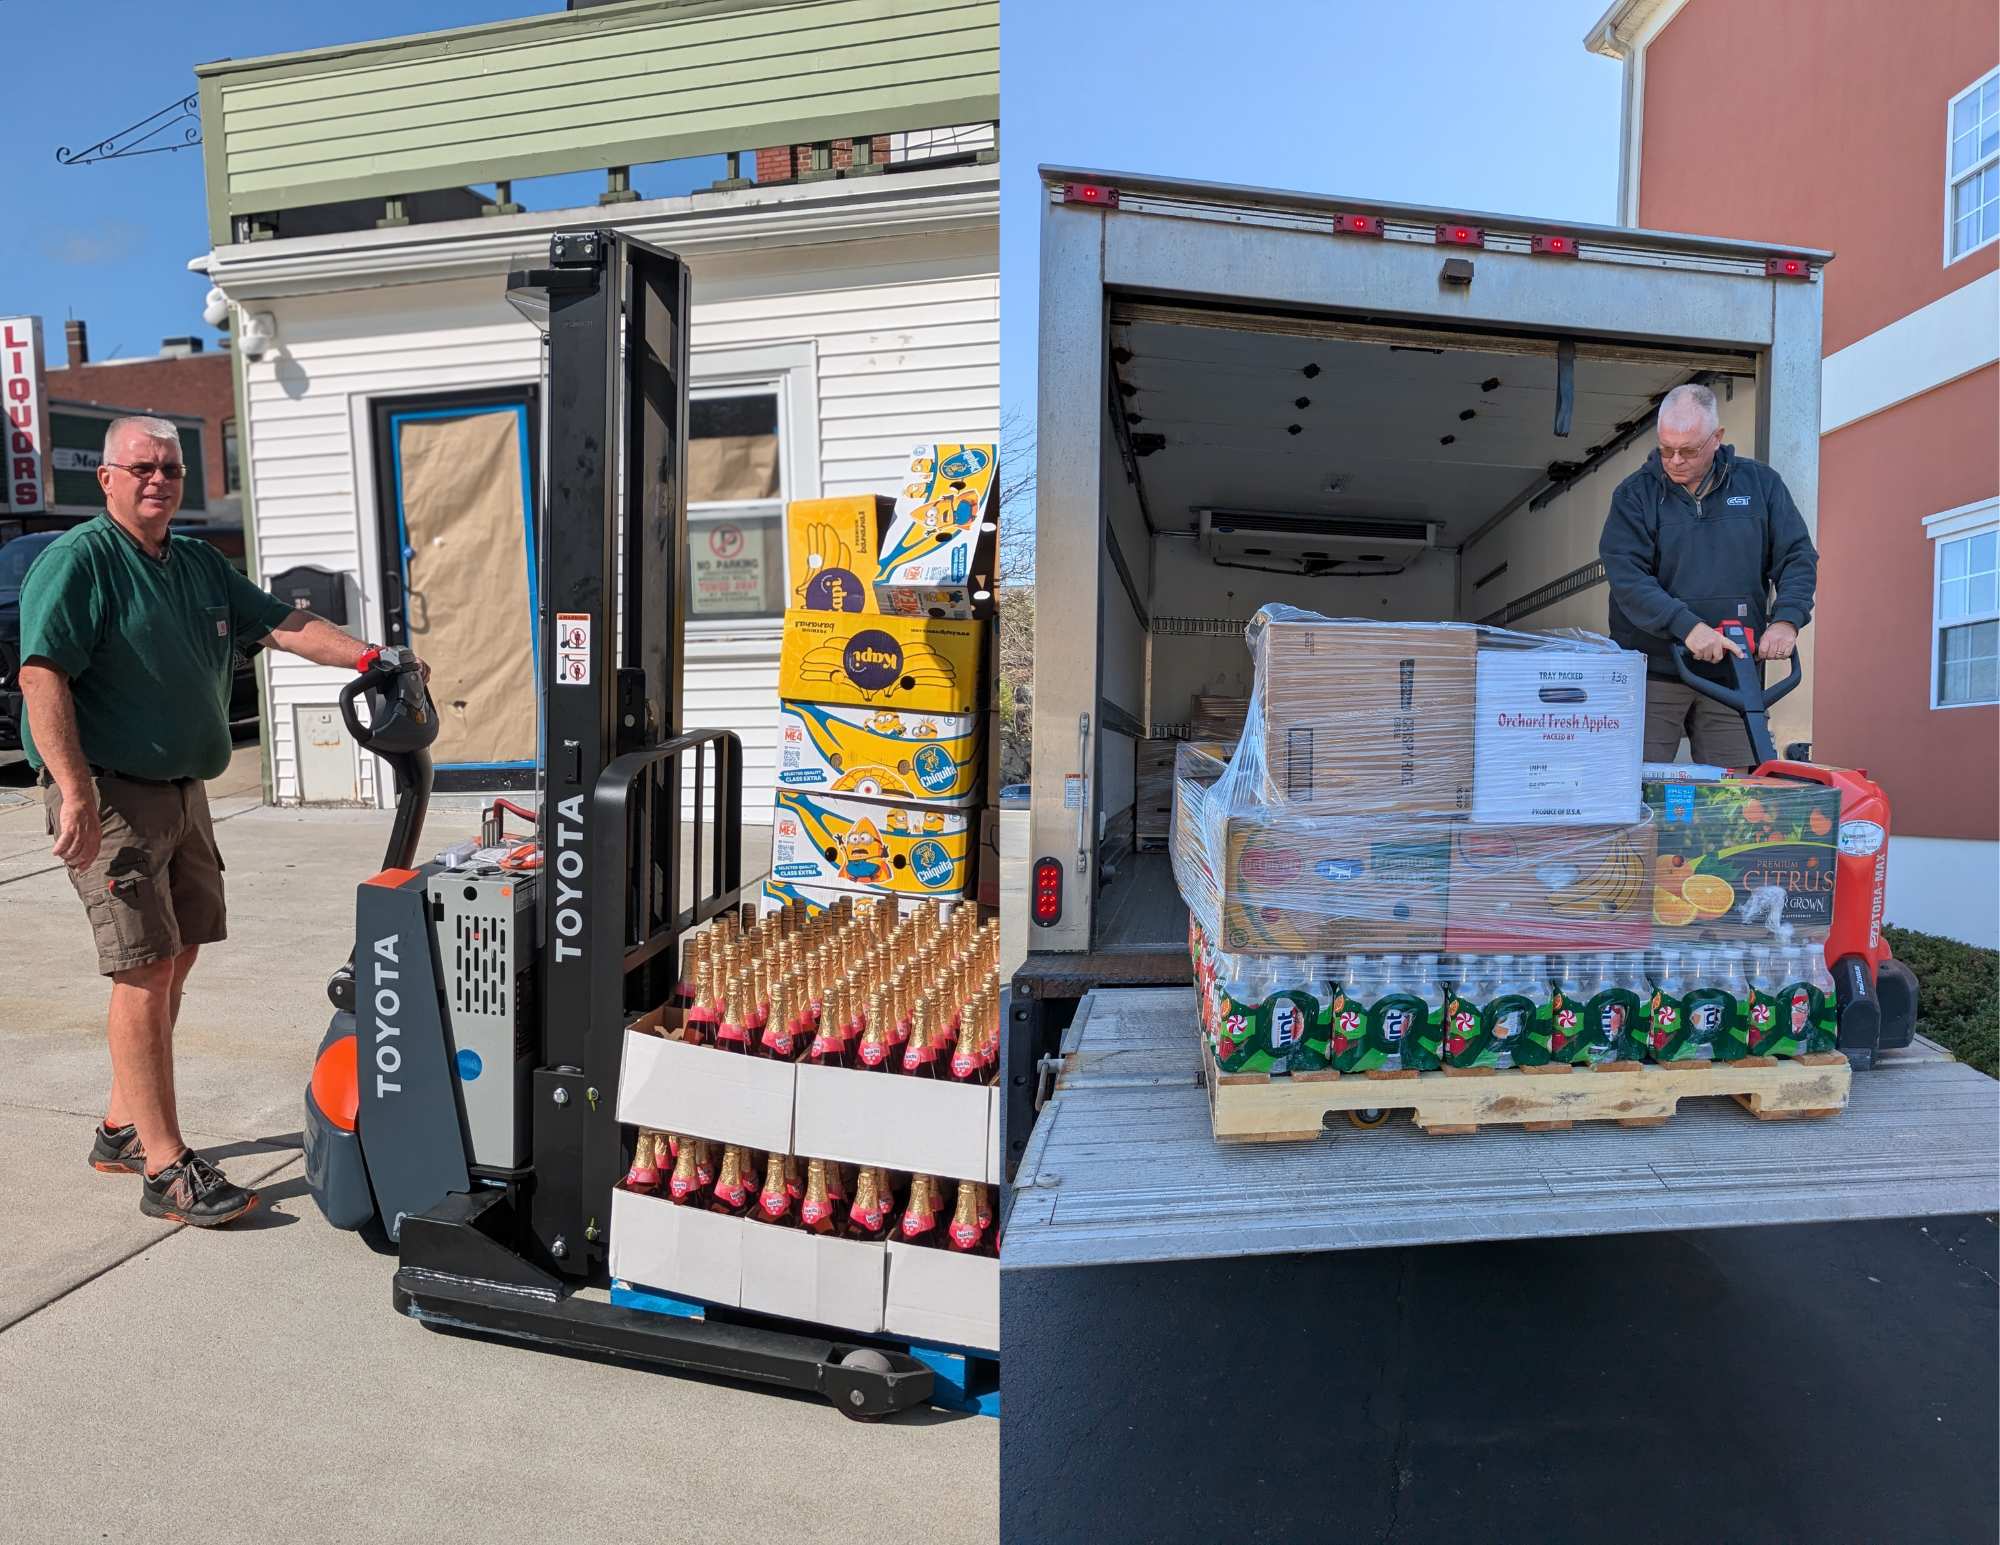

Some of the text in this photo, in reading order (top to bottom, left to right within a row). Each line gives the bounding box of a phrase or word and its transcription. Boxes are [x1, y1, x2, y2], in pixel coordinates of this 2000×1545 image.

[4, 326, 38, 505] LIQUORS
[71, 452, 101, 468] Ma
[697, 559, 759, 570] NO PARKING
[826, 577, 848, 613] api
[853, 646, 897, 670] Kapi
[1539, 672, 1583, 680] TRAY PACKED
[1498, 713, 1620, 732] Orchard Fresh Apples
[921, 764, 957, 788] Chiquita
[556, 794, 584, 963] TOYOTA
[917, 858, 954, 883] Chiquita
[1743, 870, 1834, 892] CITRUS
[1790, 897, 1825, 912] GROWN
[374, 934, 402, 1098] TOYOTA
